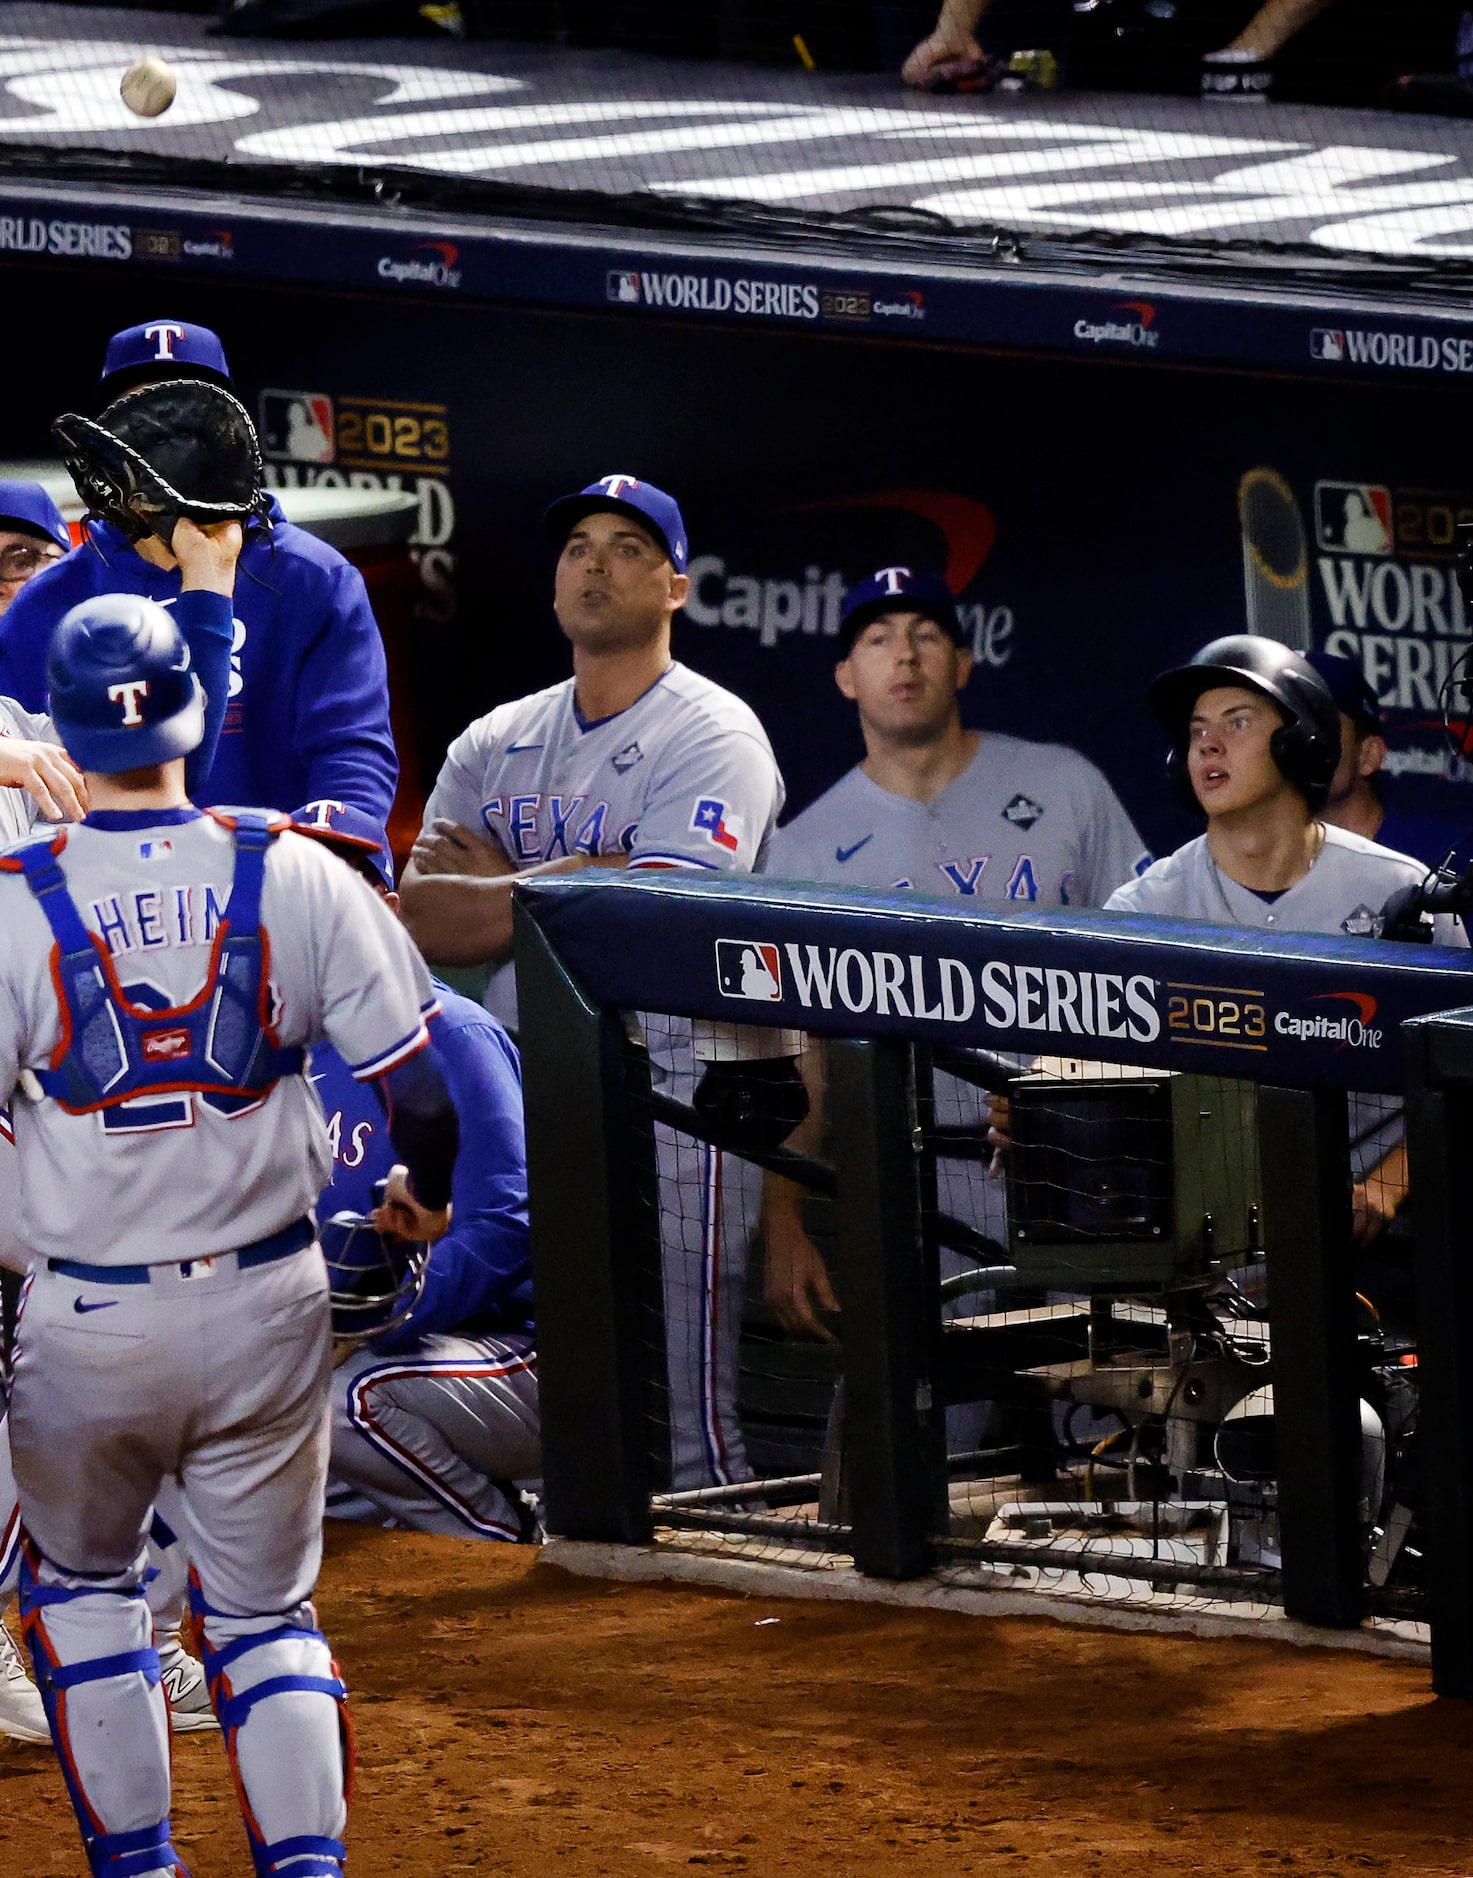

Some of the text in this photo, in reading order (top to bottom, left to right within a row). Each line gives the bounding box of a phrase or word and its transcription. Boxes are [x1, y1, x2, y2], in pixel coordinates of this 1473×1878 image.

[48, 220, 132, 259] SERIES
[641, 272, 730, 310] WORLD
[733, 279, 819, 319] SERIES
[144, 324, 185, 358] T
[1345, 330, 1440, 369] WORLD
[338, 413, 449, 459] 2023
[599, 474, 640, 495] T
[875, 567, 910, 595] T
[107, 680, 152, 726] T
[306, 799, 346, 829] T
[784, 943, 976, 1022] WORLD
[981, 961, 1160, 1044] SERIES
[1167, 996, 1267, 1037] 2023
